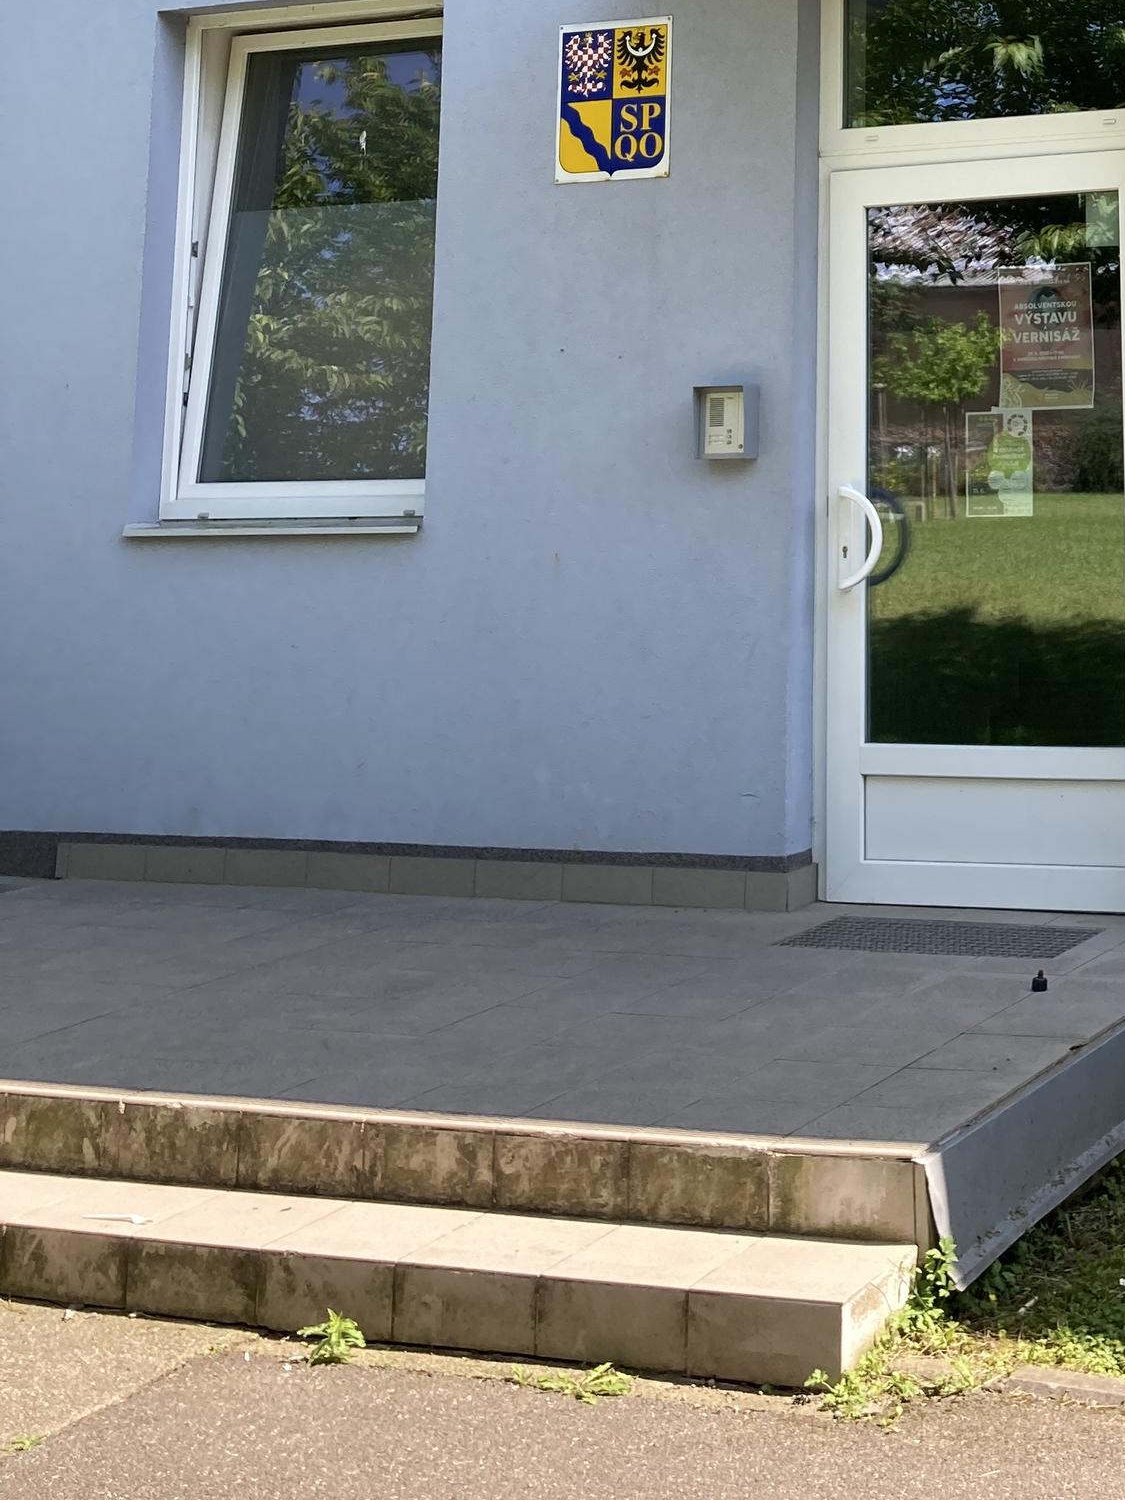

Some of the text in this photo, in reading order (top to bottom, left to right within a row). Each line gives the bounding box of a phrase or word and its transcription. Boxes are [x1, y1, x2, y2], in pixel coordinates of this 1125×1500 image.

[620, 102, 661, 133] SP
[614, 132, 663, 161] QO
[1014, 300, 1077, 310] ABSOLVENTSKOU
[1014, 311, 1077, 325] VÝSTAVU
[1013, 326, 1080, 344] VERNISÁŽ
